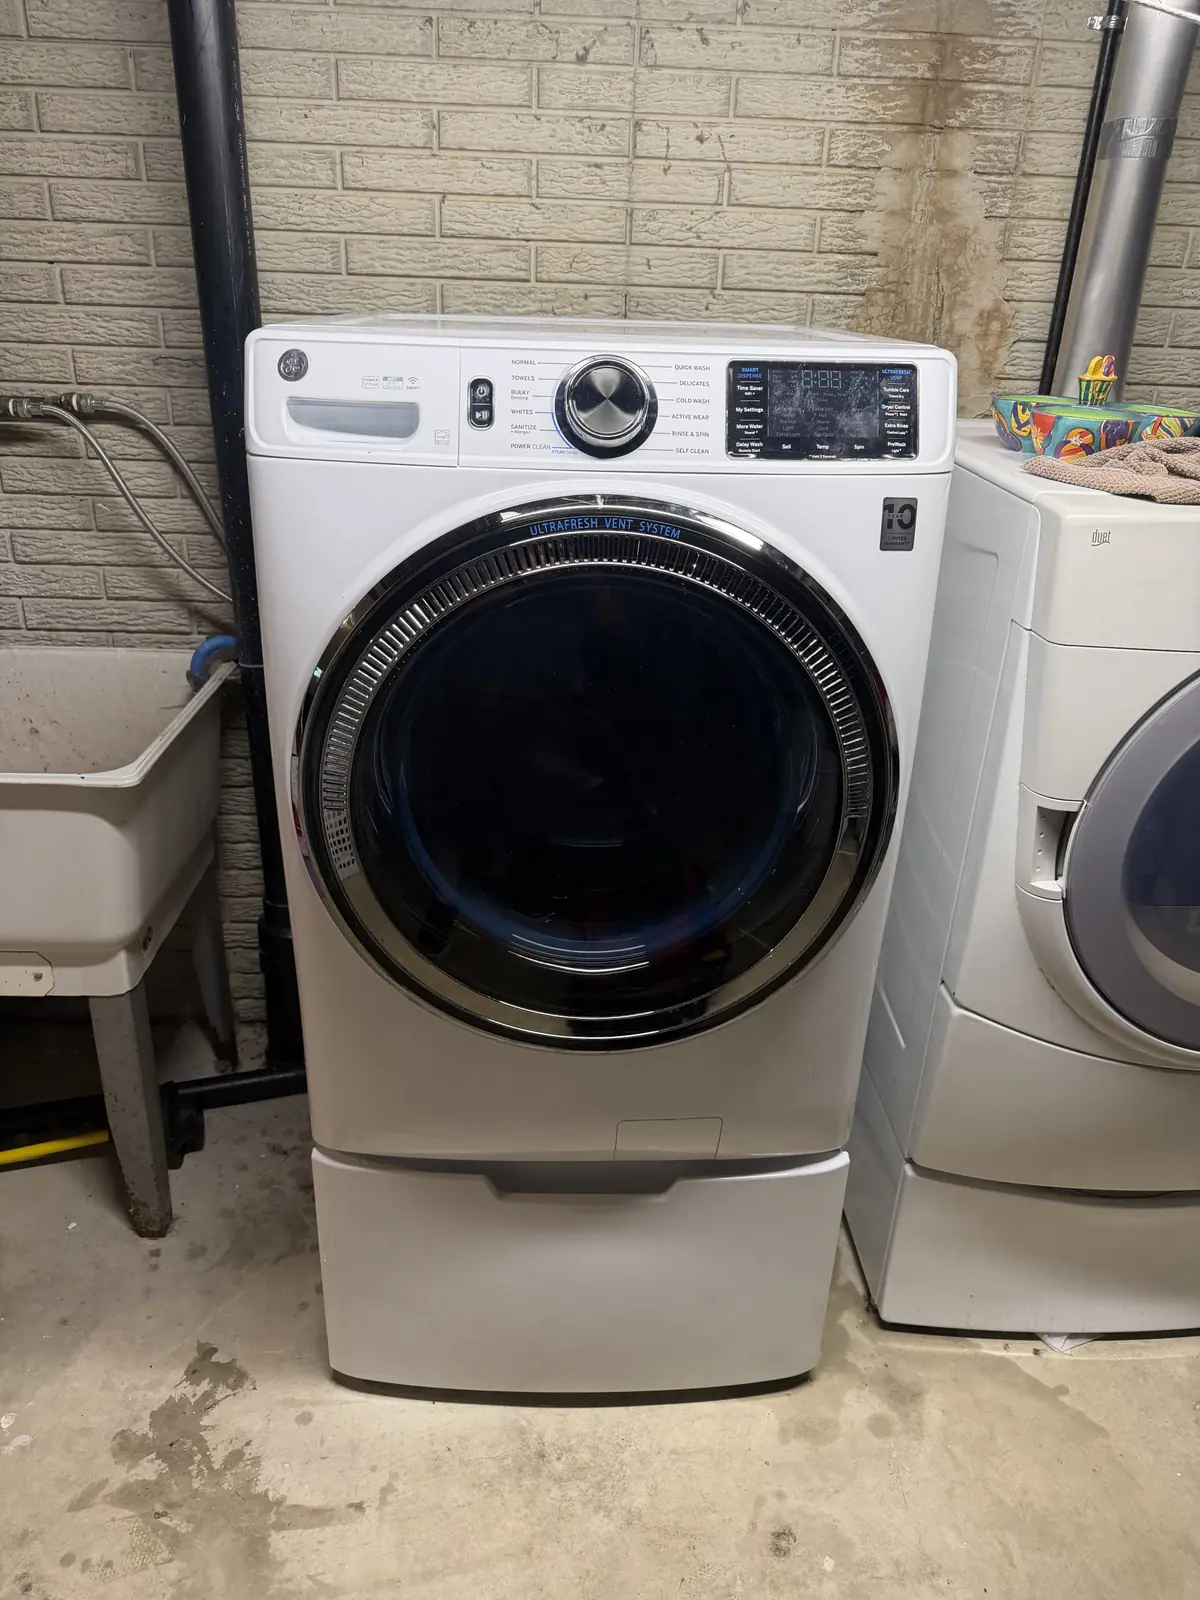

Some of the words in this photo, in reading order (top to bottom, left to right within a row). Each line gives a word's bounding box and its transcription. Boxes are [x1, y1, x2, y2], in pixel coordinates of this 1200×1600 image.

[883, 503, 917, 530] 10
[529, 518, 598, 536] ULTRAFRESH
[604, 518, 634, 530] VENT
[639, 521, 681, 540] SYSTEM
[1091, 528, 1112, 546] duet
